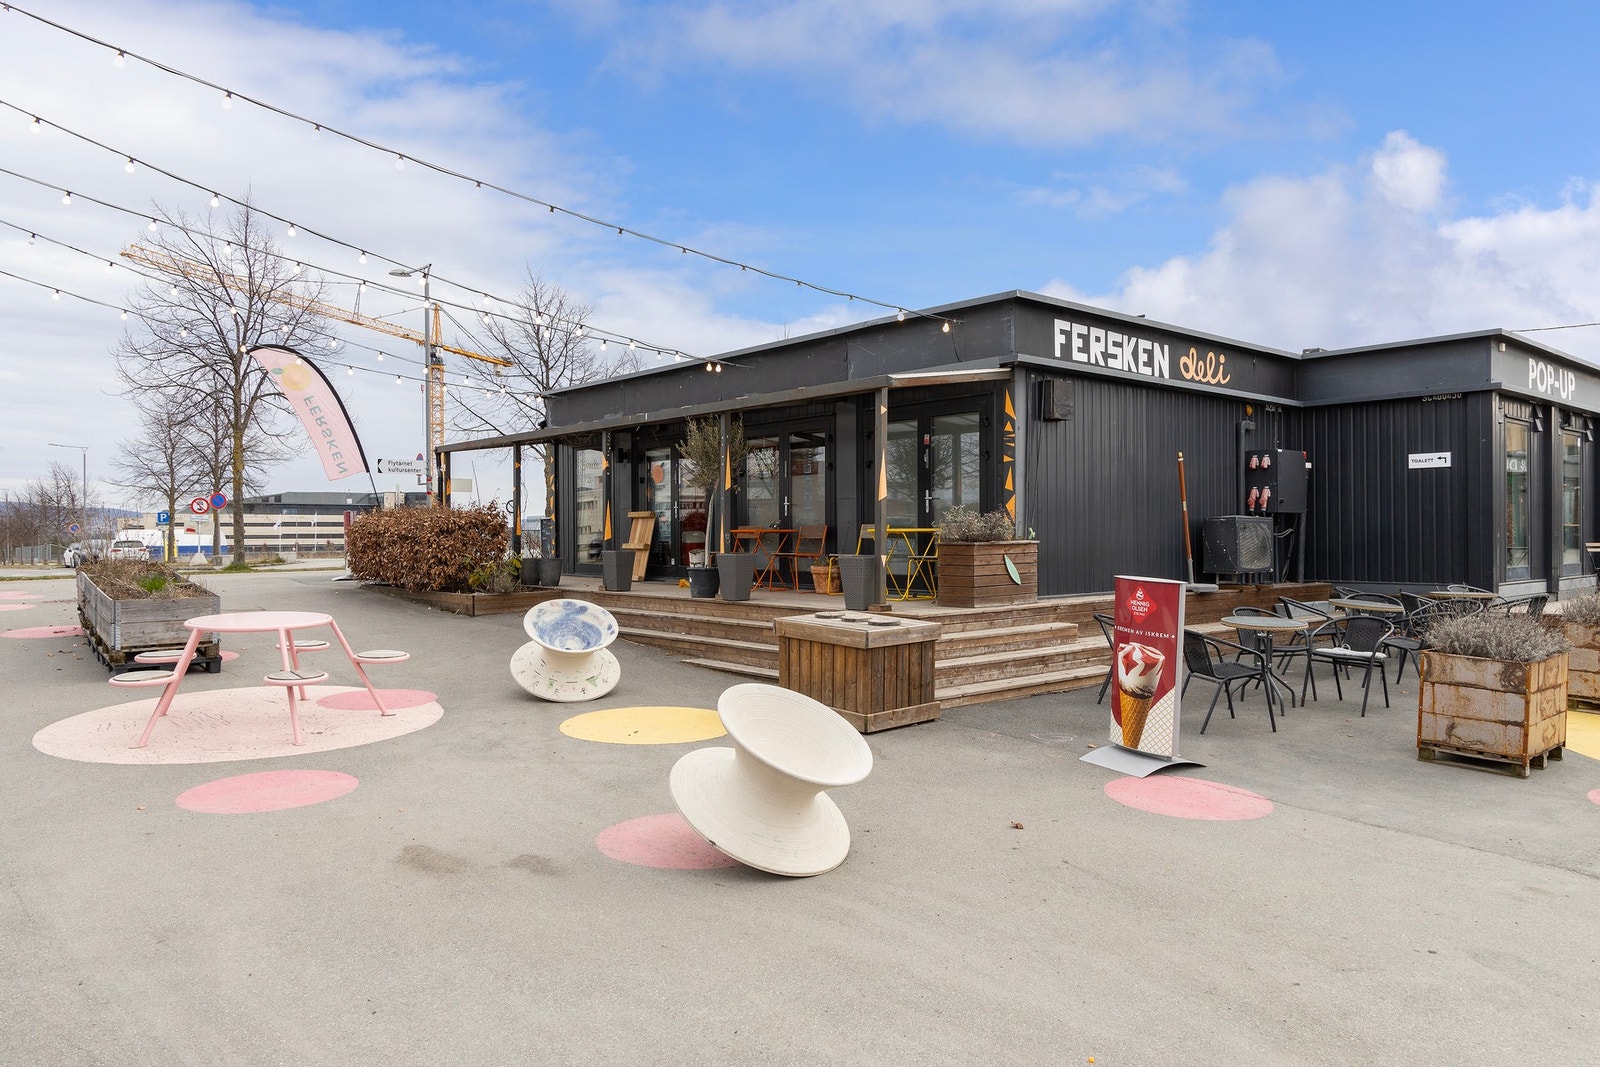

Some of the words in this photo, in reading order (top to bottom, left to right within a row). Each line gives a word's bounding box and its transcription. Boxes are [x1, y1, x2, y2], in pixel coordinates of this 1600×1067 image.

[1054, 318, 1170, 379] FERSKEN
[1179, 347, 1231, 385] deli
[1528, 357, 1576, 401] POP-UP
[160, 513, 167, 522] P
